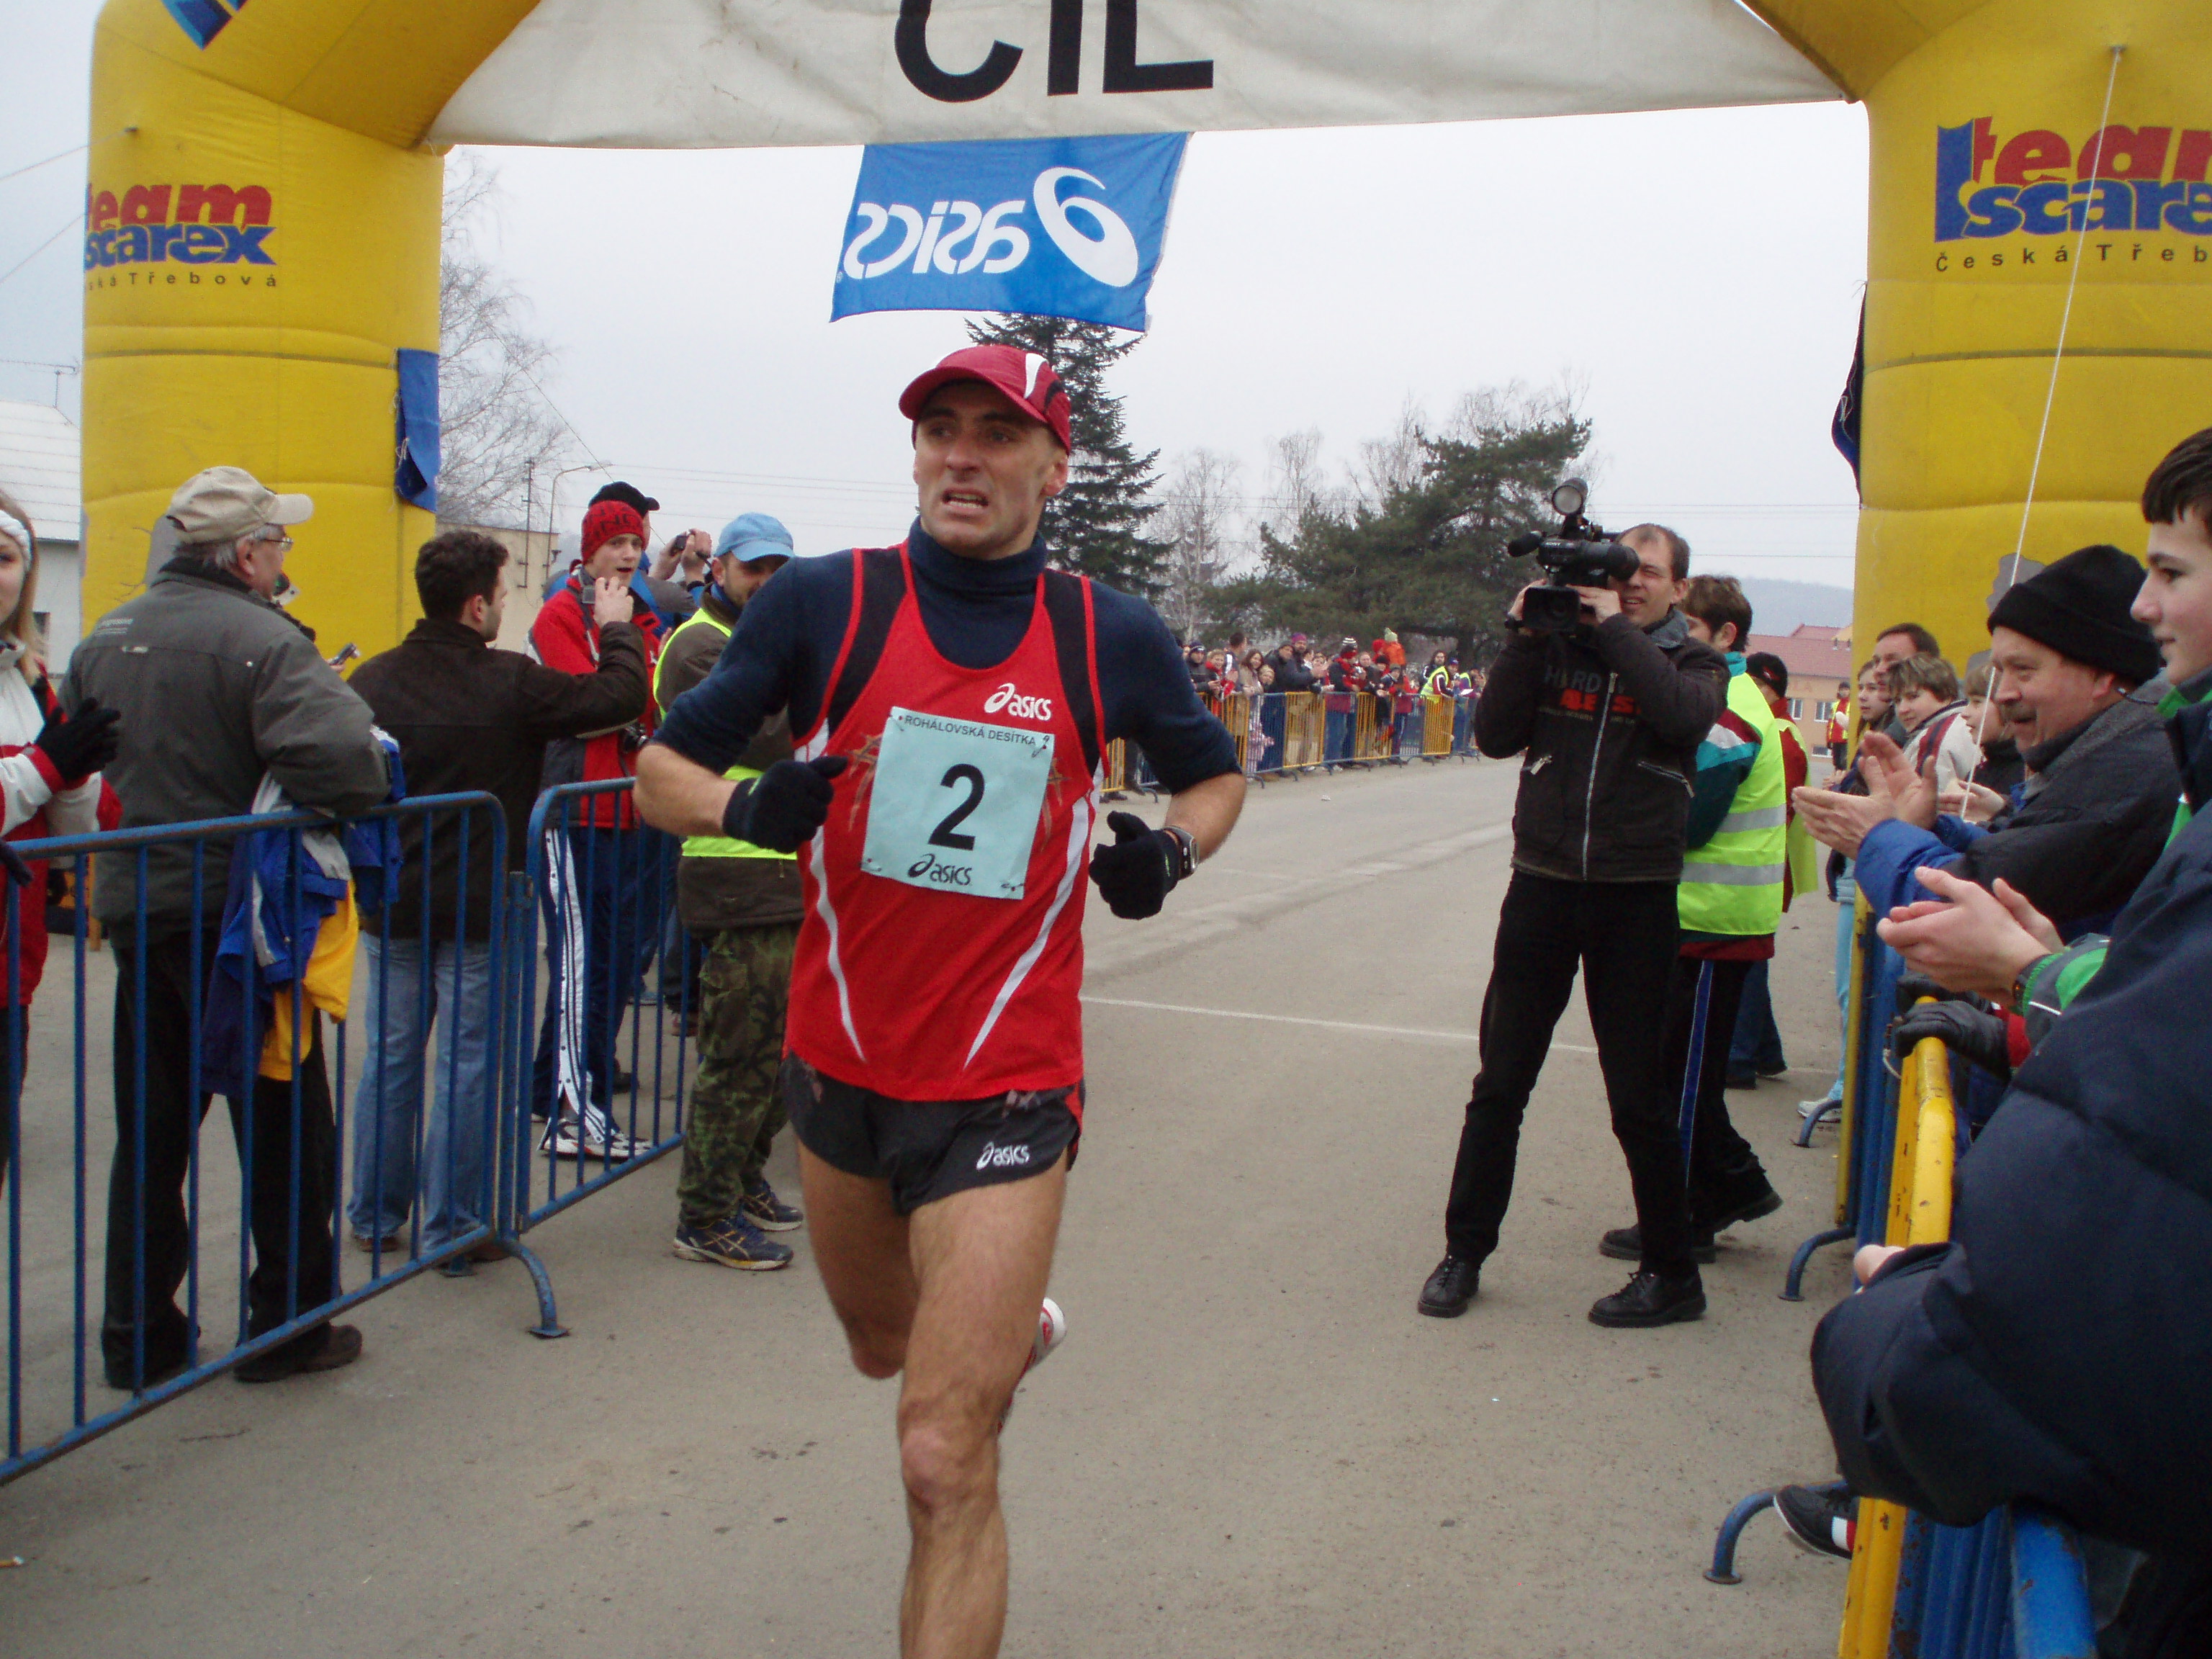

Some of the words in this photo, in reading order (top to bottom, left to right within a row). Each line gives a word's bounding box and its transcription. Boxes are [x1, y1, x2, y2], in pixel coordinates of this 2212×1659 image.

[1962, 179, 2212, 238] scare
[1936, 245, 2069, 272] Česká
[2096, 243, 2212, 264] Třeb
[88, 272, 117, 291] ská
[128, 271, 278, 287] Třebová
[1543, 665, 1602, 693] HRD
[1007, 693, 1052, 721] asics
[903, 714, 986, 739] ROHÁLOVSKÁ
[987, 727, 1036, 747] DESÍTKA
[927, 762, 986, 851] 2
[931, 863, 972, 885] asics
[992, 1144, 1030, 1166] asics
